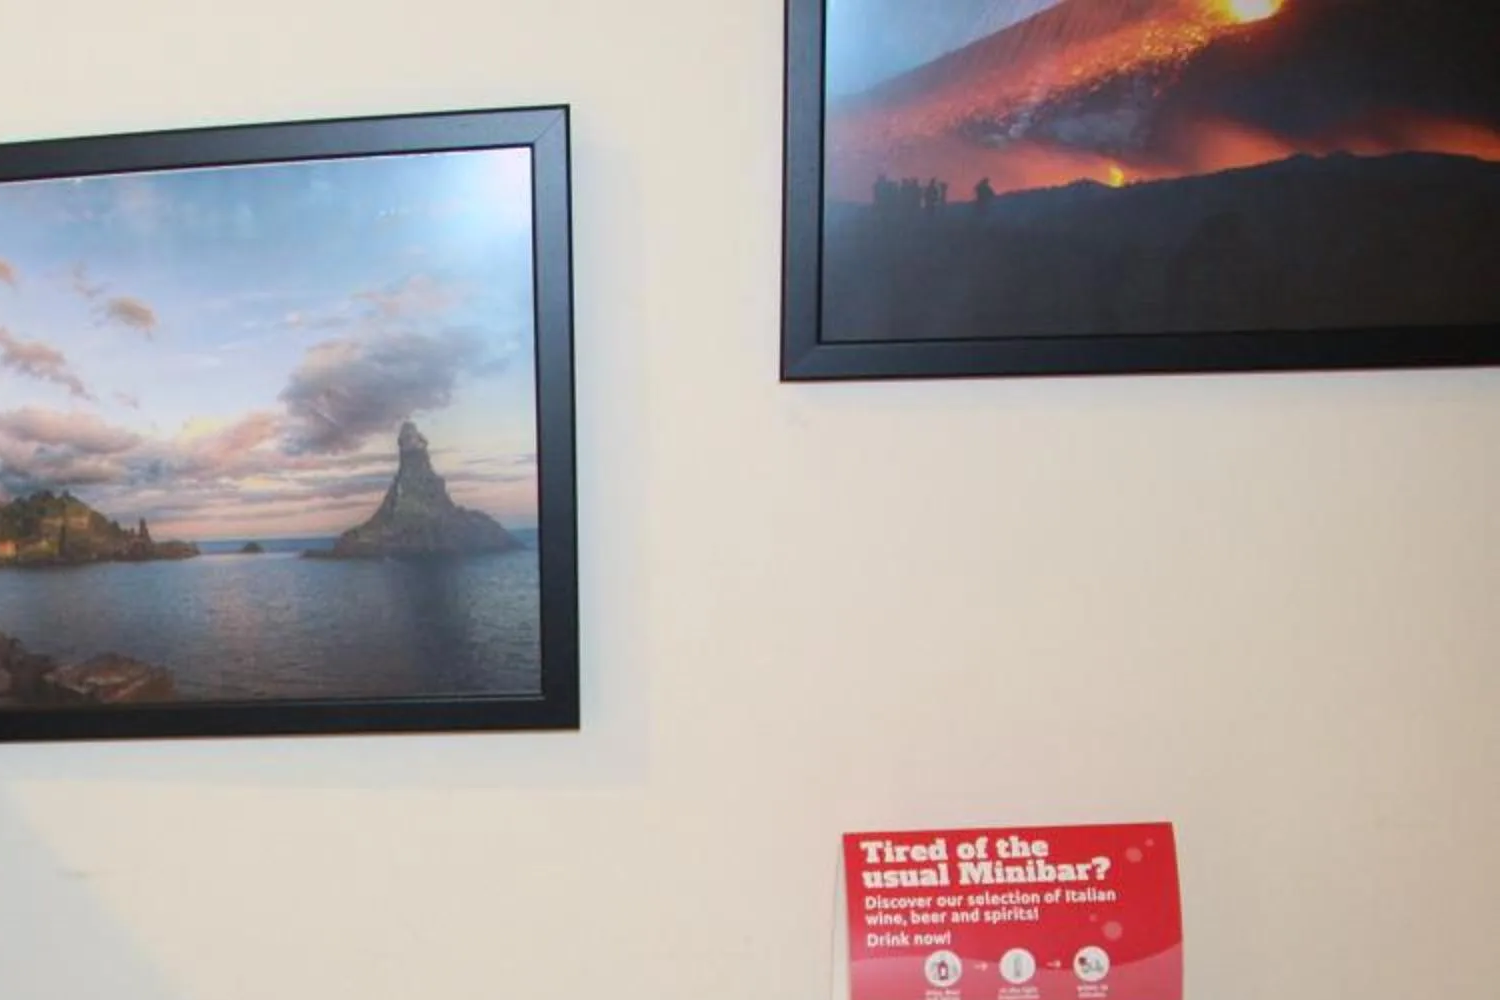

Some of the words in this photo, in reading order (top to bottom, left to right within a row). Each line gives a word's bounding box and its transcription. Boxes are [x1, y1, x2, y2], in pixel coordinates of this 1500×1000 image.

[860, 837, 949, 863] Tired
[956, 837, 989, 860] of
[995, 835, 1049, 858] the
[862, 864, 949, 888] usual
[958, 856, 1111, 886] Minibar?
[865, 894, 932, 910] Discover
[936, 895, 962, 908] our
[968, 892, 1041, 906] selection
[1044, 889, 1061, 904] of
[1065, 889, 1117, 903] Italian
[865, 911, 907, 926] wine,
[910, 909, 947, 924] beer
[950, 908, 980, 923] and
[984, 907, 1039, 925] spirits!
[867, 933, 909, 947] Drink
[913, 931, 951, 946] now!
